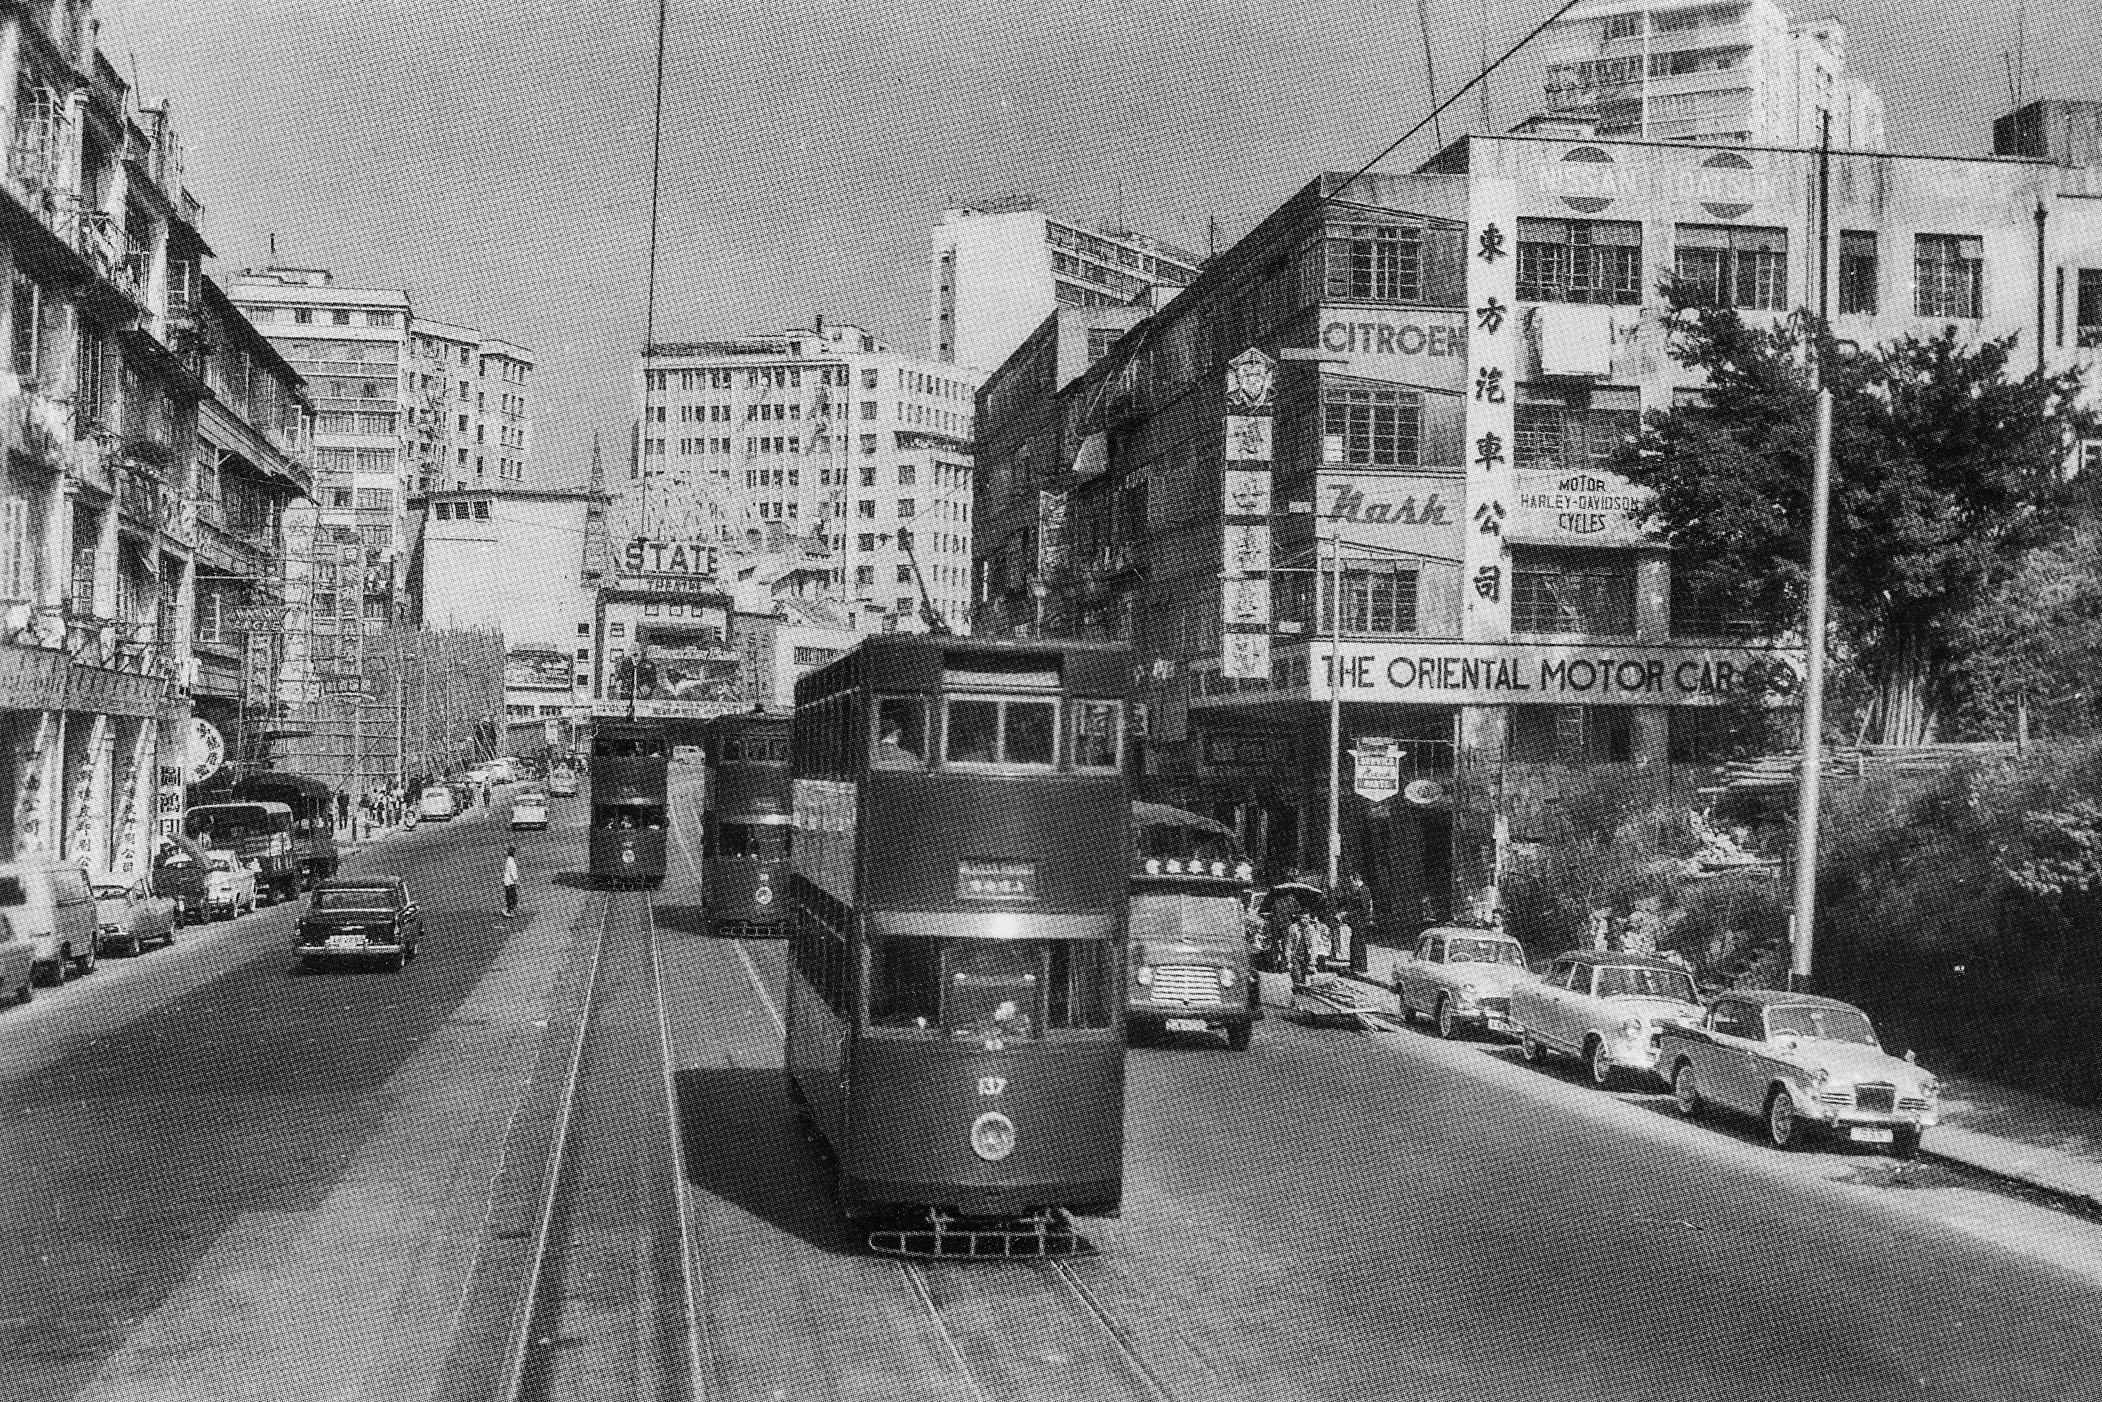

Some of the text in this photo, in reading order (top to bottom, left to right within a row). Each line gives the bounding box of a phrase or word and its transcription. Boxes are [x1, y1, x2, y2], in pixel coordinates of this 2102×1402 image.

[1538, 167, 1638, 193] NISSAN
[1322, 321, 1467, 358] CITROEN
[1472, 221, 1508, 604] 東方汽車公司
[1558, 474, 1606, 492] MOTOR
[1322, 484, 1455, 526] Nash
[1520, 494, 1639, 512] HARLEY-DAVIDSON
[1558, 513, 1606, 534] CYCLES
[624, 542, 719, 575] STATE
[1321, 655, 1375, 692] THE
[1386, 655, 1530, 692] ORIENTAL
[1541, 656, 1663, 694] MOTOR
[1674, 660, 1733, 695] CAR
